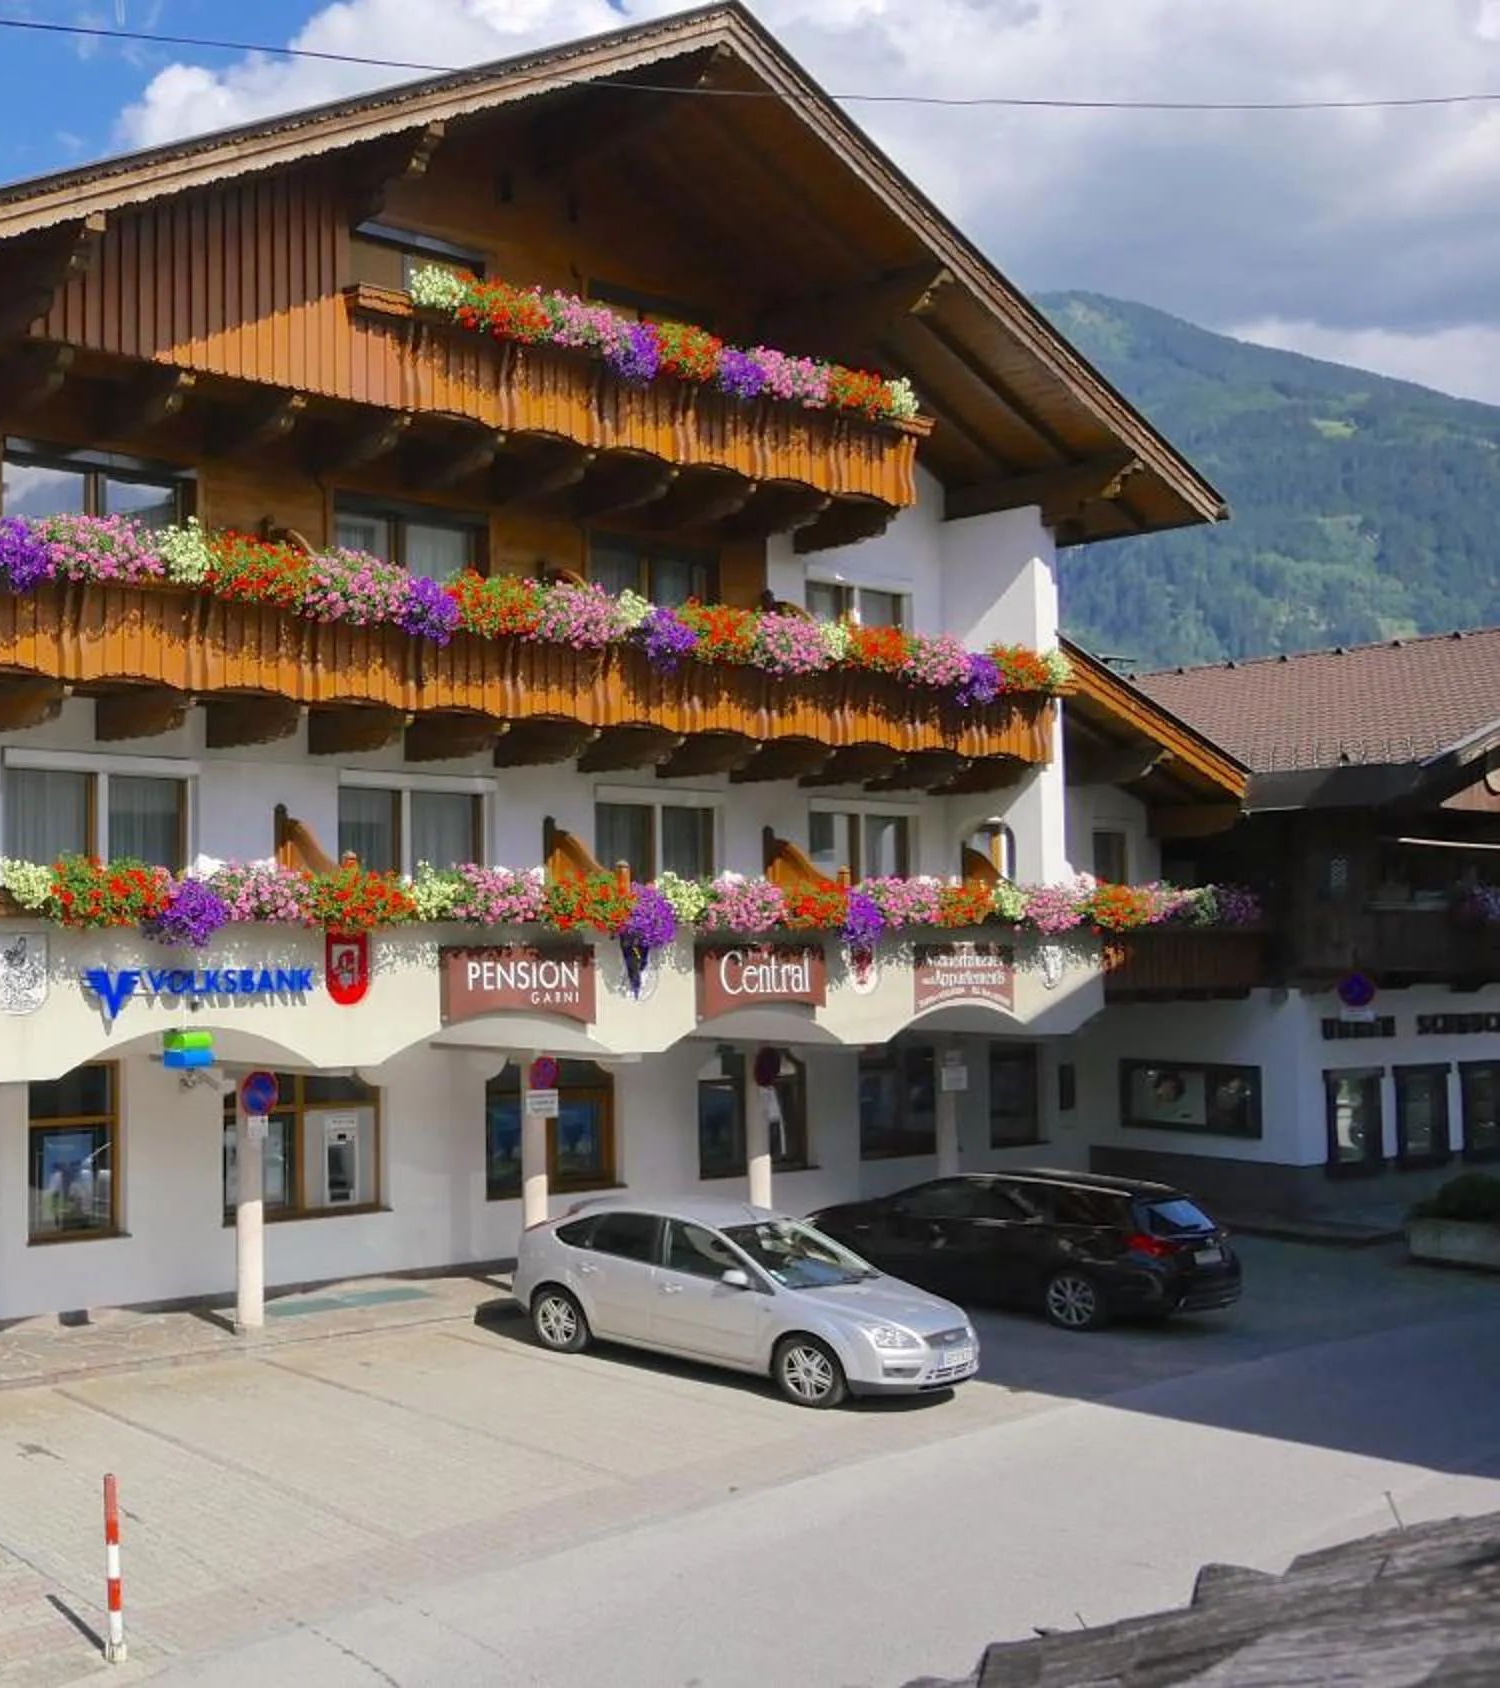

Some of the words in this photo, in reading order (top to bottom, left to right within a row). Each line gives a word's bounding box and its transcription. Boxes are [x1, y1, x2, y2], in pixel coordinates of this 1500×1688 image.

[146, 967, 314, 993] VOLKSBANK
[467, 960, 580, 991] PENSION
[720, 948, 811, 995] Central
[531, 992, 580, 1004] GARNI
